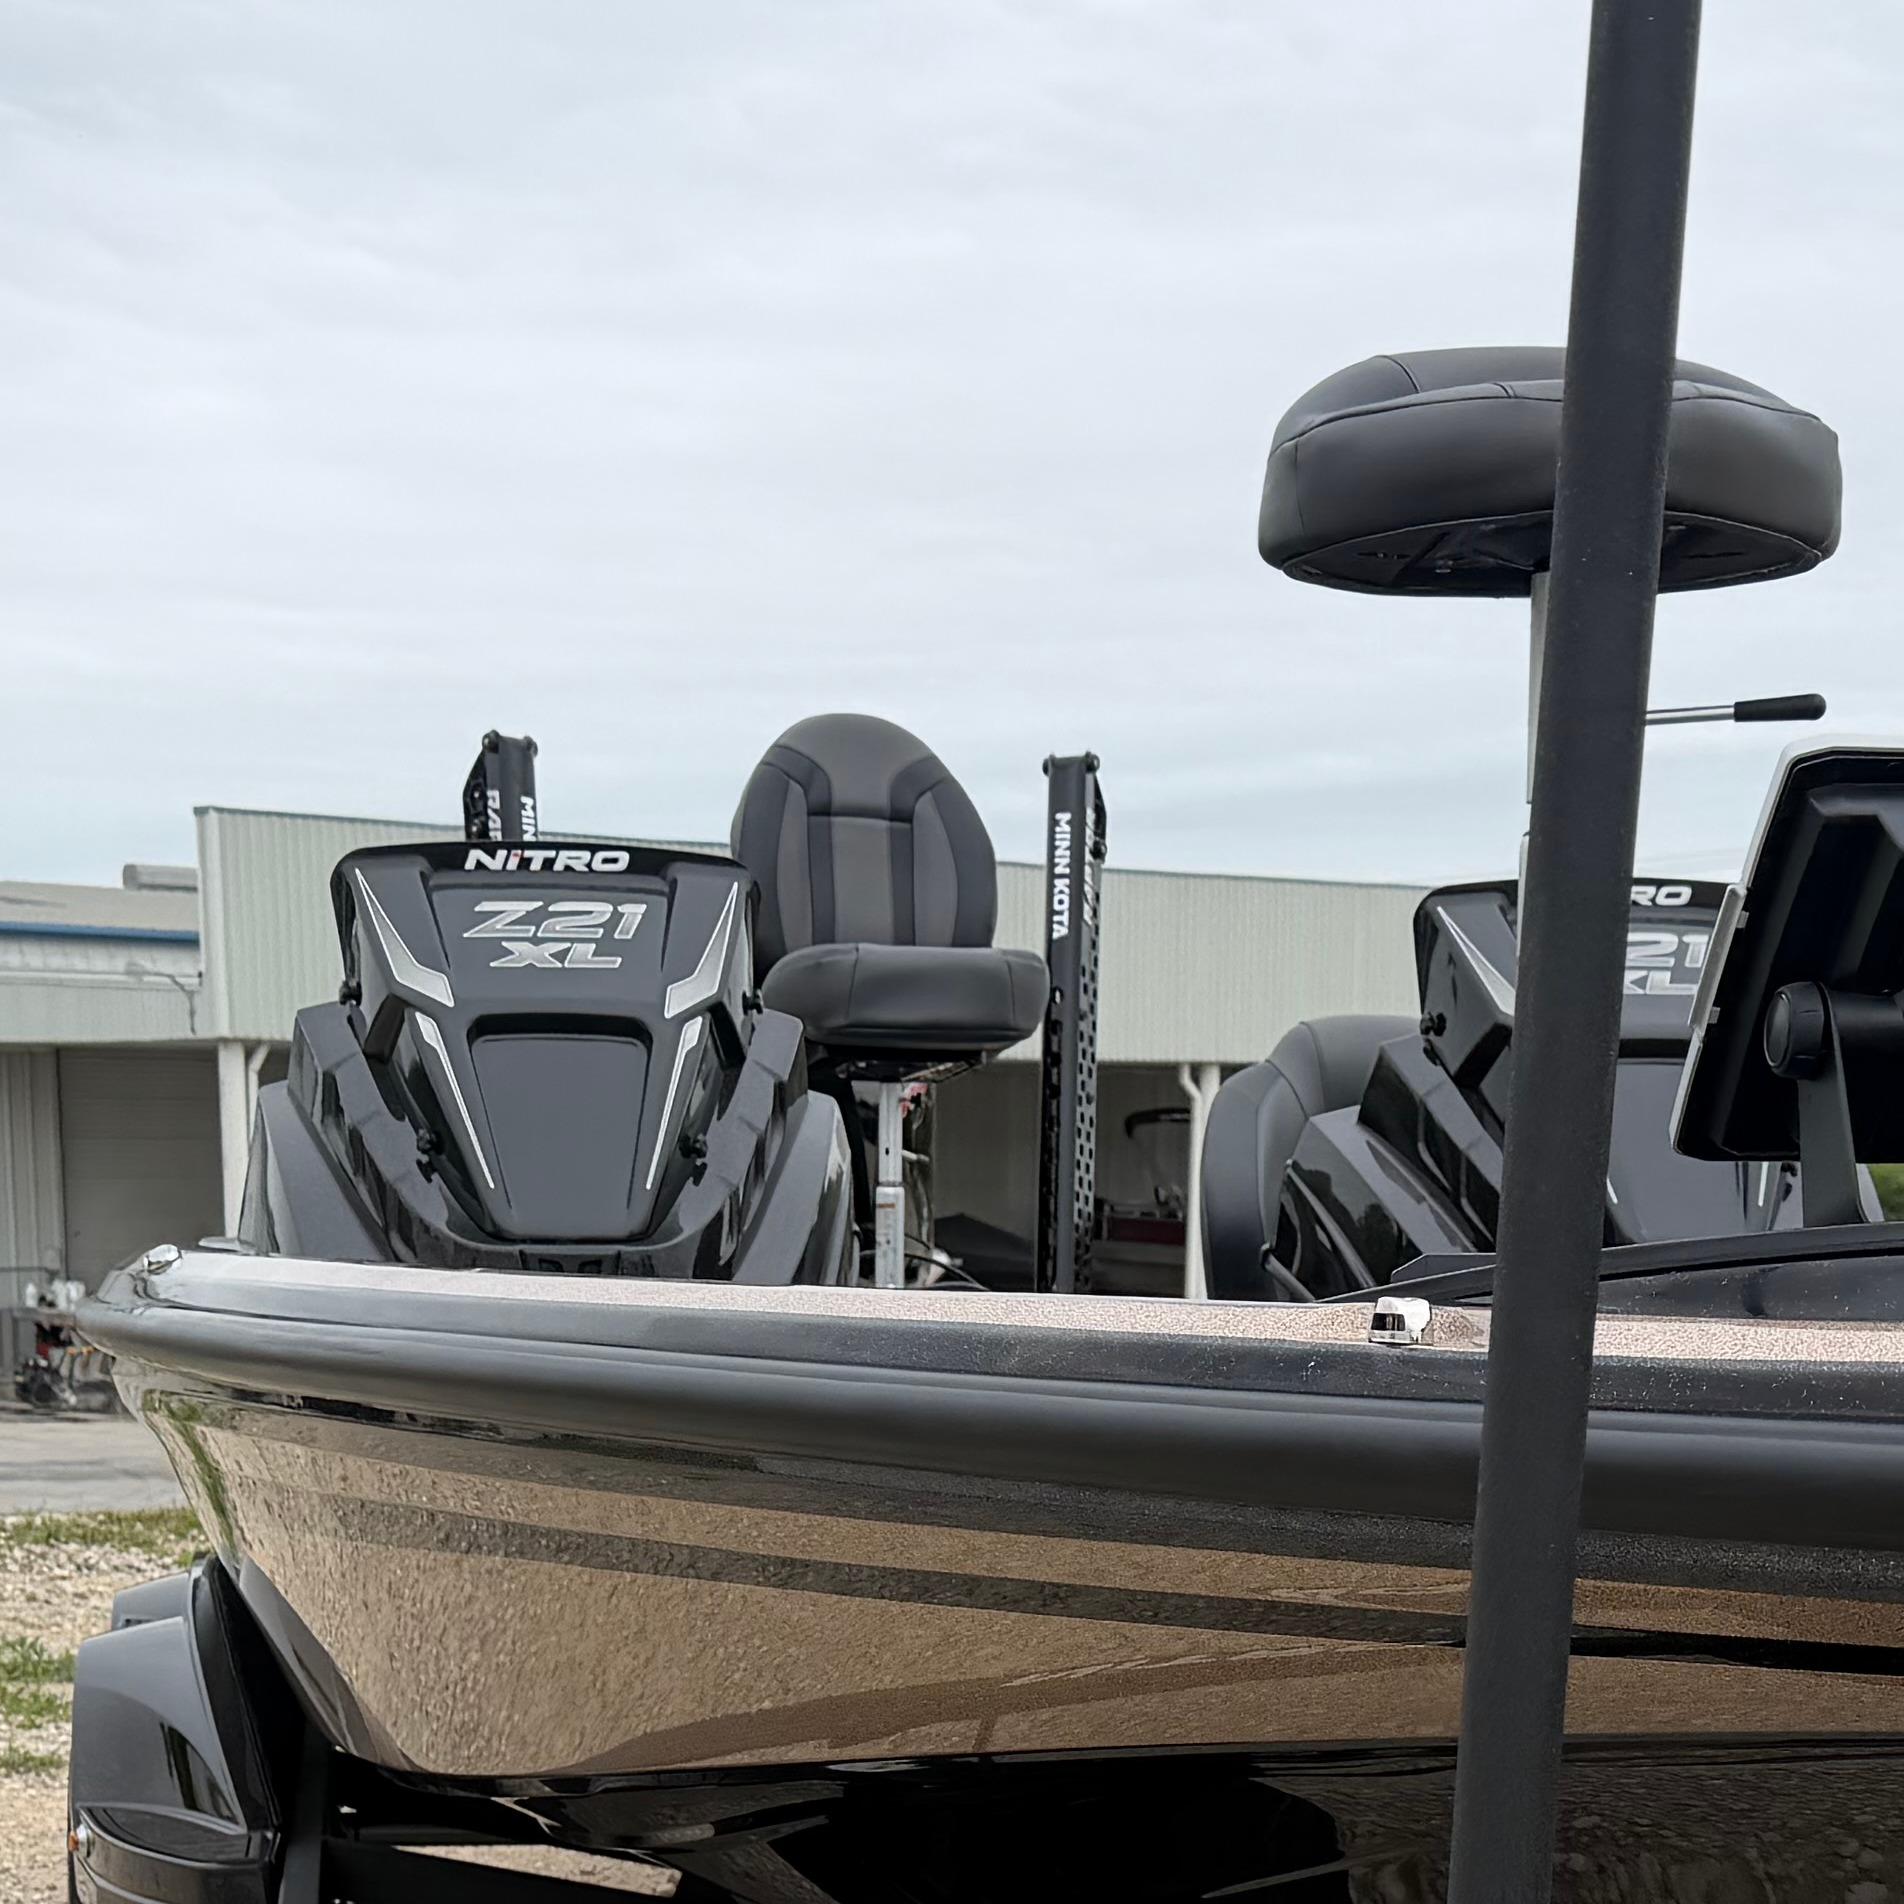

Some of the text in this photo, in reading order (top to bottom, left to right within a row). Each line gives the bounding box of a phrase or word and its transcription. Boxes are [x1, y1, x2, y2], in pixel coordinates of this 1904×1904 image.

[1052, 812, 1072, 940] MINN KOTA
[463, 901, 647, 939] Z21
[489, 941, 622, 968] XL
